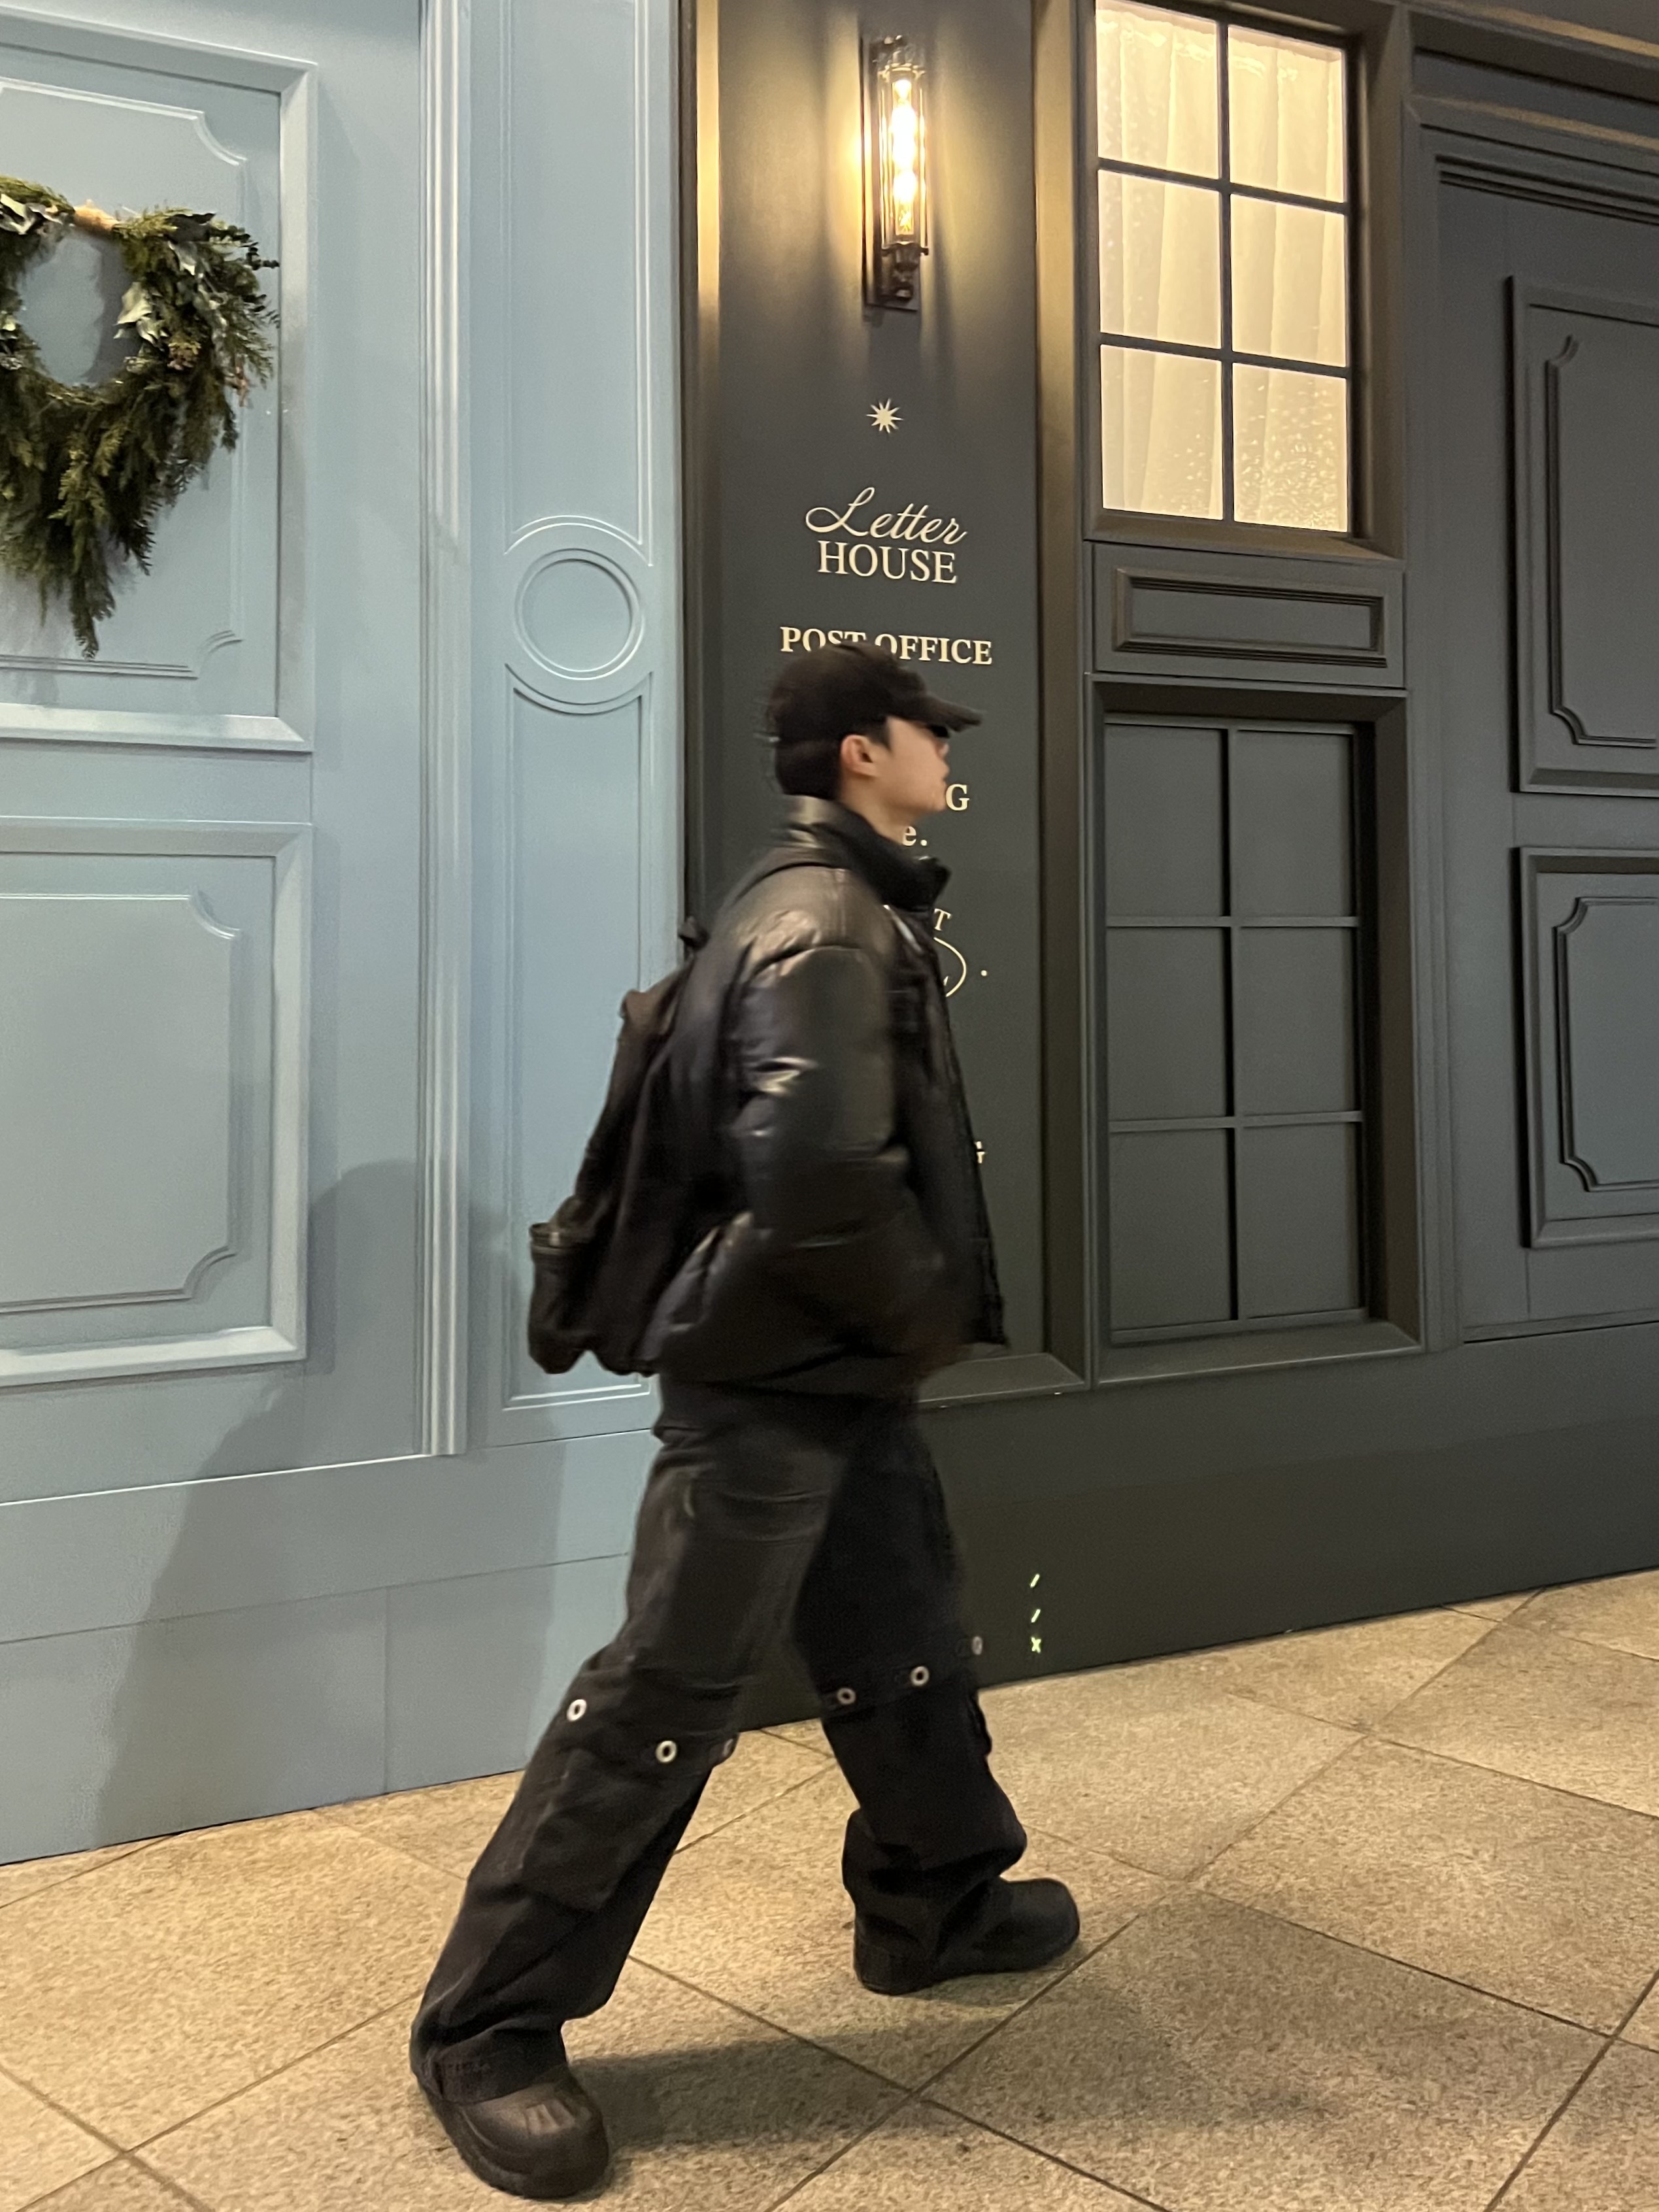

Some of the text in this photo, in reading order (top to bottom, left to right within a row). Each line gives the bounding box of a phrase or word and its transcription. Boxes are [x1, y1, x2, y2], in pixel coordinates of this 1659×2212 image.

[805, 486, 967, 545] Letter
[817, 540, 957, 584] HOUSE
[875, 633, 993, 665] OFFICE
